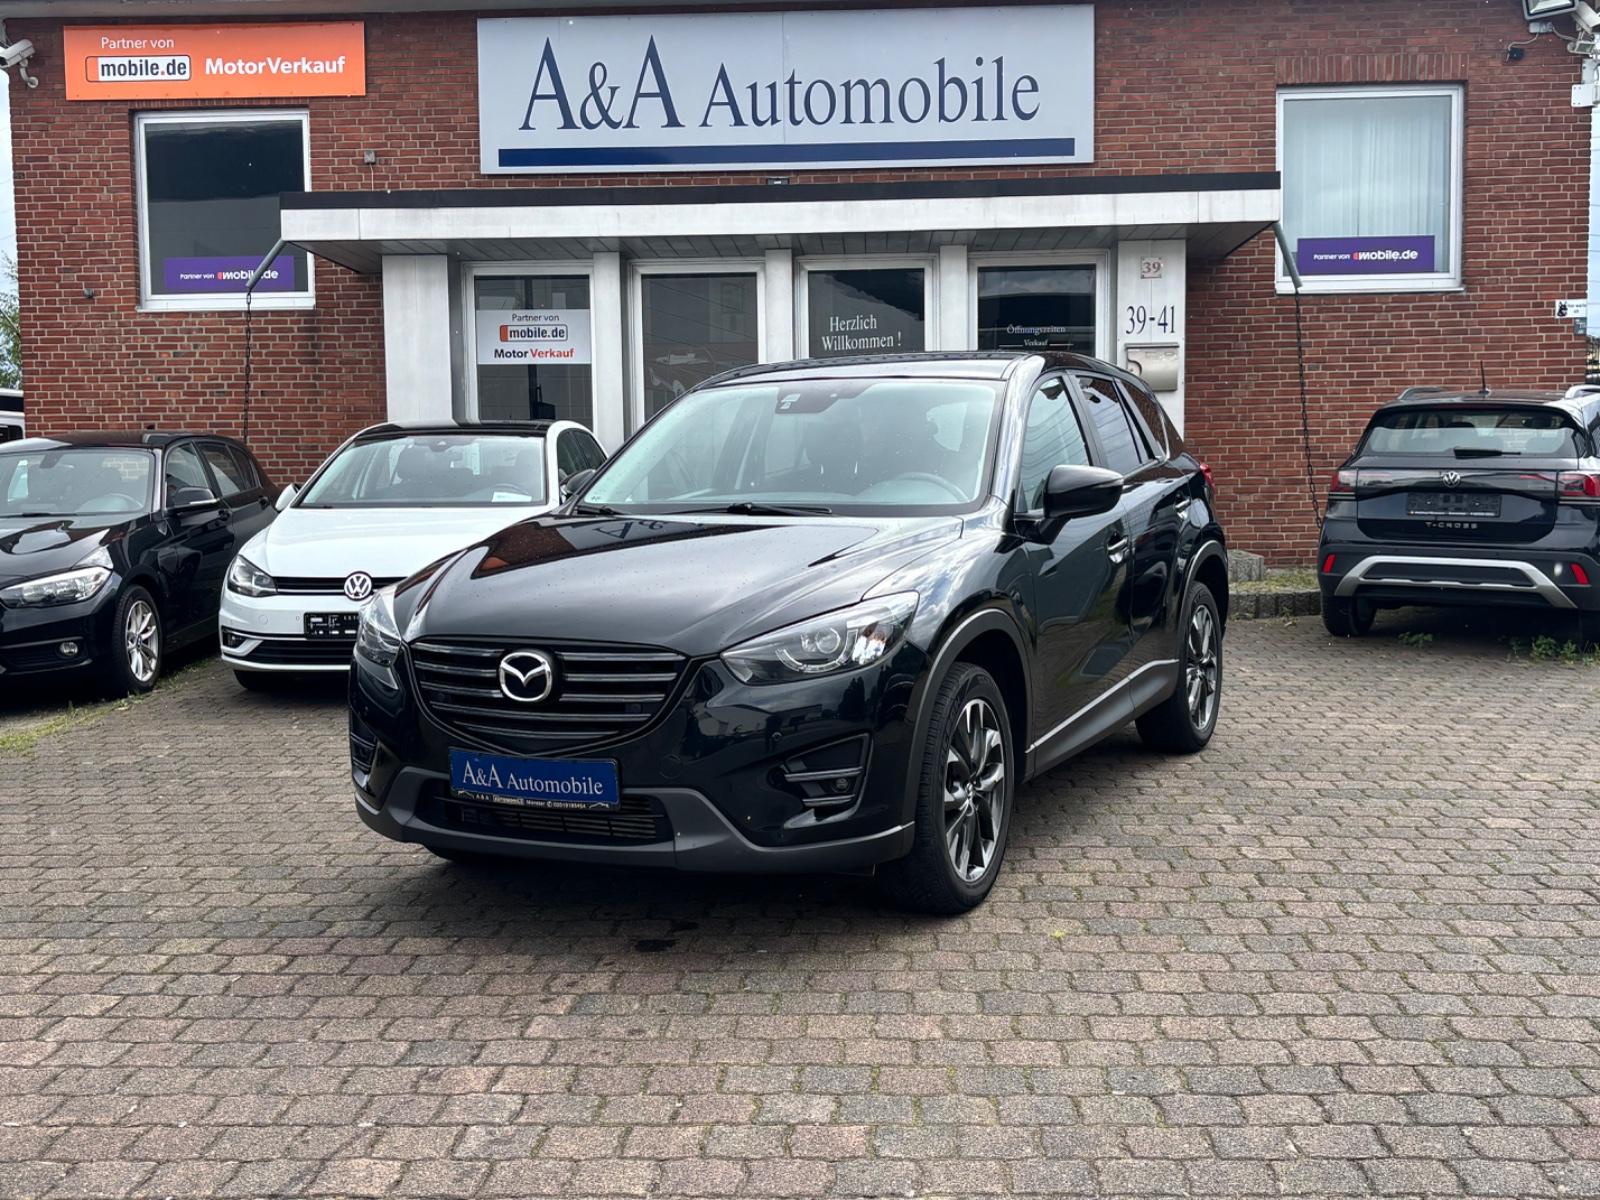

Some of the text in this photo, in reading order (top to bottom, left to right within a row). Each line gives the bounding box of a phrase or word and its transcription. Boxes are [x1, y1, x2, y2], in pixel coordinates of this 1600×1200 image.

[101, 37, 174, 49] Partner von
[101, 59, 187, 77] mobile.de
[518, 34, 1041, 131] A&A Automobile
[1358, 249, 1418, 261] mobile.de
[1142, 261, 1161, 274] 39
[222, 269, 279, 280] mobil.de
[511, 313, 541, 322] Partner
[829, 314, 877, 332] Herzlich
[1125, 305, 1176, 335] 39-41
[509, 327, 565, 338] mobile.de
[1006, 323, 1066, 336] Öffnungszeiten
[821, 334, 894, 351] Willkommen
[494, 347, 575, 359] Motor Verkauf
[462, 759, 604, 796] A&A Automobile
